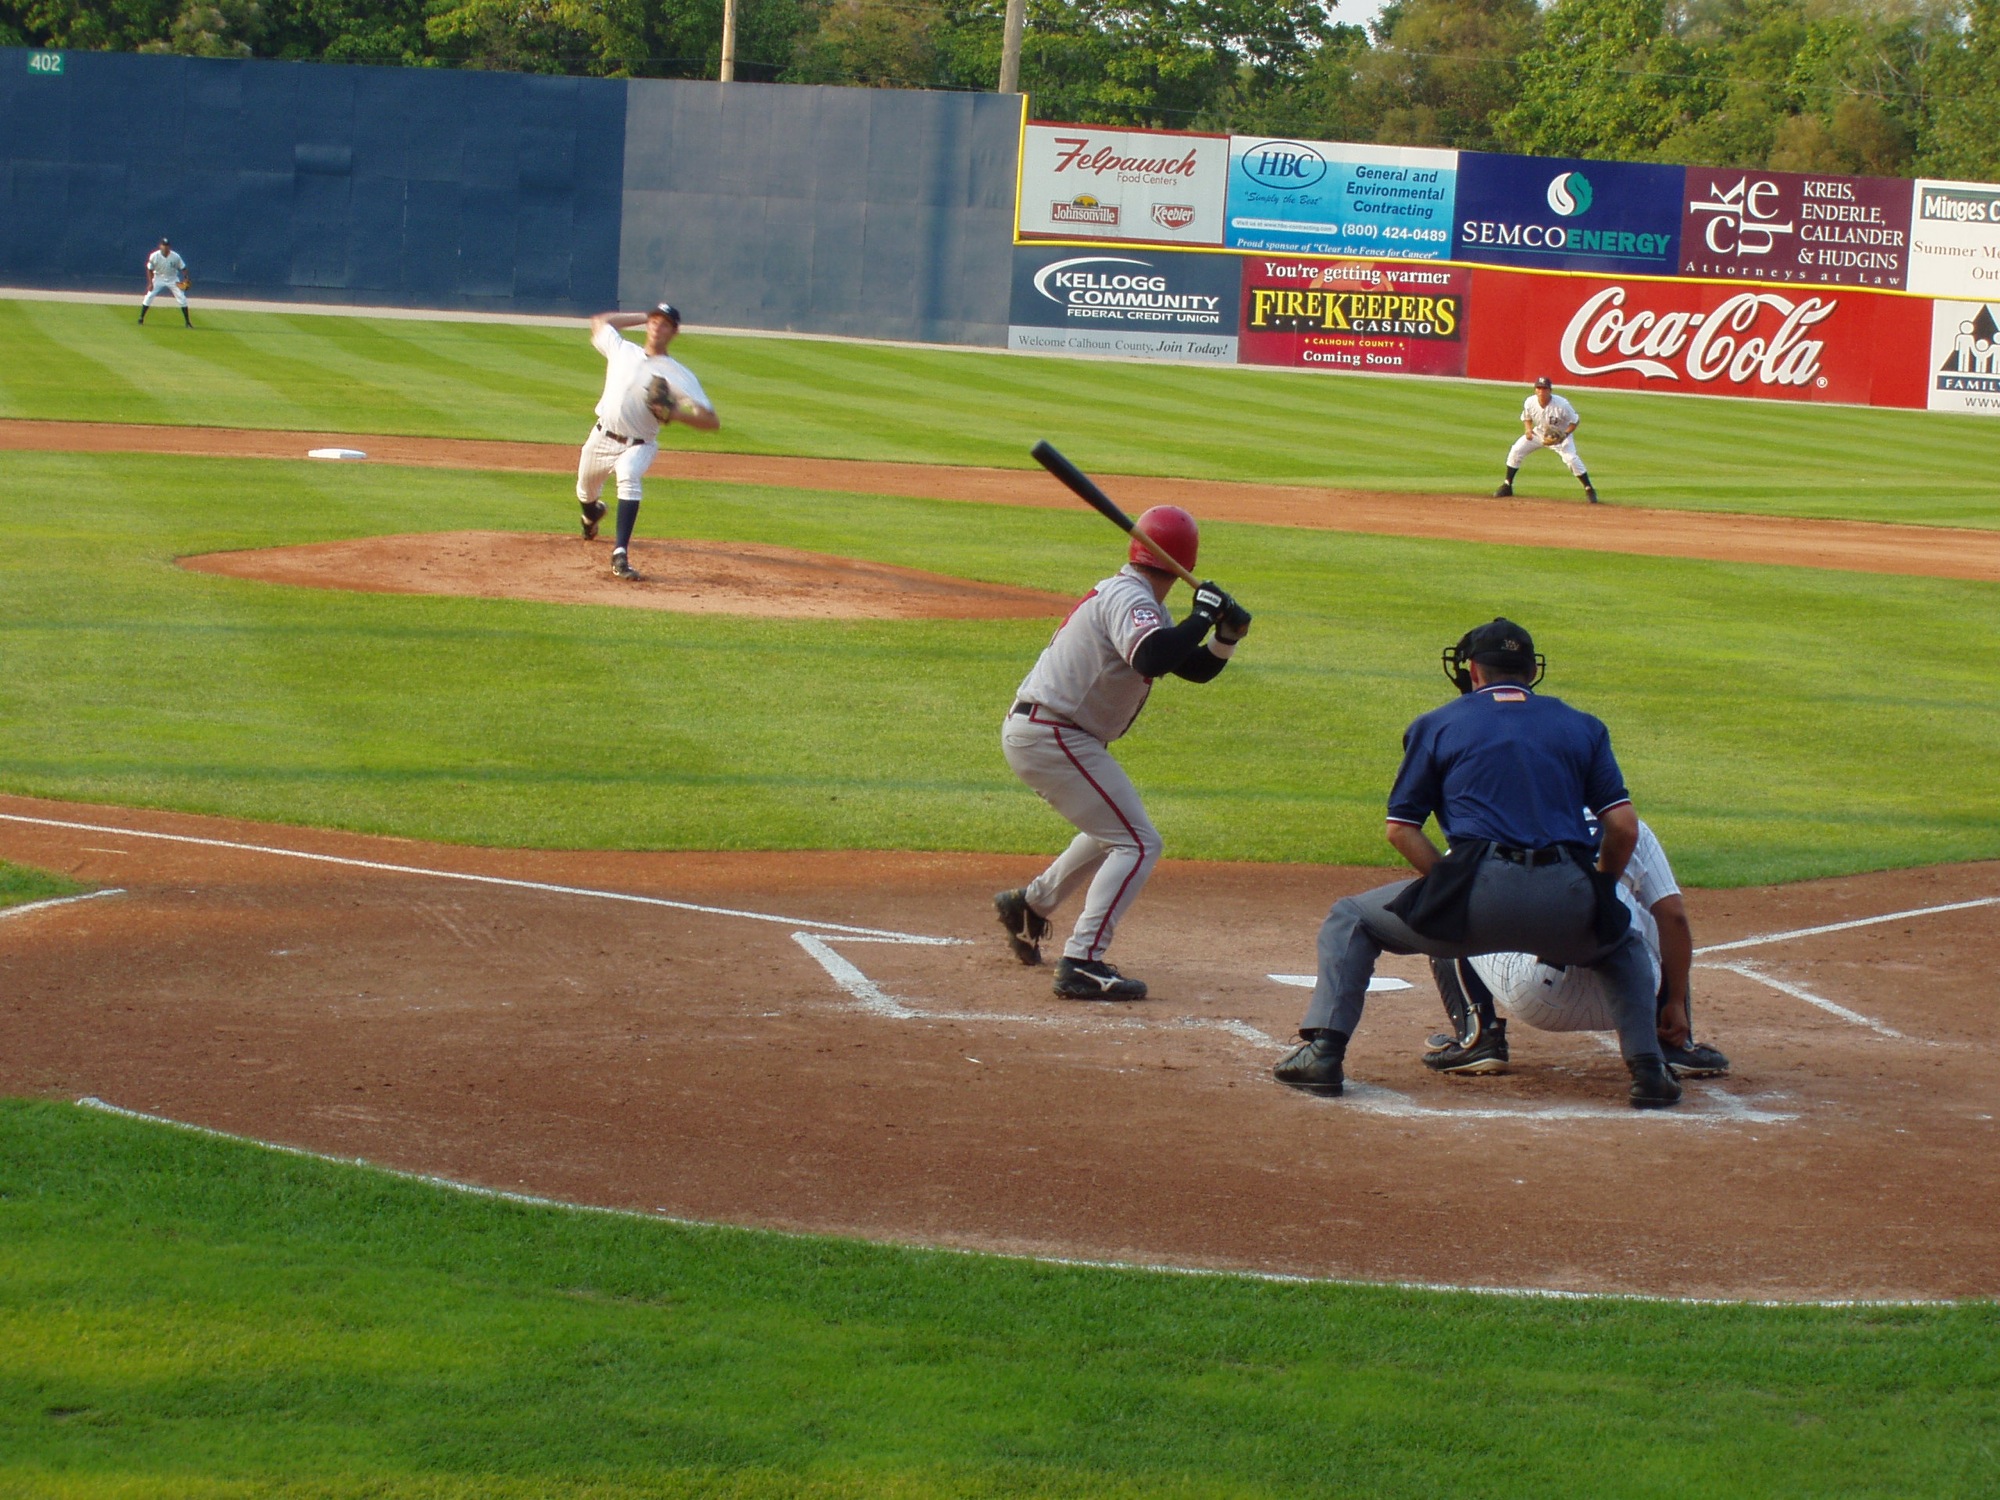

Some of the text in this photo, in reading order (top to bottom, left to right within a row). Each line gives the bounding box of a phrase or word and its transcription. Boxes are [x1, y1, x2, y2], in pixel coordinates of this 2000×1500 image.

[30, 53, 61, 72] 402
[1054, 137, 1197, 177] Felpausch
[1257, 151, 1314, 178] HBC
[1117, 172, 1178, 186] Food Centers
[1356, 166, 1438, 183] General and
[1283, 194, 1295, 204] the
[1346, 182, 1445, 201] Environmental
[1803, 181, 1856, 202] KREIS,
[1054, 205, 1115, 223] Johnsonville
[1153, 204, 1194, 222] Keebler
[1353, 201, 1434, 219] Contracting
[1802, 204, 1886, 226] ENDERLE,
[1925, 195, 1985, 221] Minges
[1342, 223, 1447, 241] (800) 424-0489
[1801, 225, 1903, 247] CALLANDER
[1237, 238, 1263, 248] Proud
[1266, 240, 1299, 251] sponsor
[1301, 243, 1312, 252] of
[1344, 246, 1358, 254] the
[1359, 247, 1385, 256] Fence
[1387, 248, 1400, 258] for
[1914, 241, 1977, 257] Summer
[1798, 248, 1898, 270] & HUDGINS
[1056, 272, 1165, 291] KELLOGG
[1265, 263, 1450, 284] You're getting warmer
[1686, 261, 1900, 285] Attorneys at Law
[1069, 291, 1219, 310] COMMUNITY
[1067, 308, 1219, 323] FEDERAL CREDIT UNION
[1353, 320, 1431, 334] CASINO
[1560, 286, 1837, 385] Coca-Cola
[1019, 335, 1066, 347] Welcome
[1069, 337, 1110, 349] Calhoun
[1156, 340, 1182, 353] Join
[1187, 342, 1228, 355] Today!
[1313, 338, 1355, 346] CALHOUN
[1303, 350, 1402, 365] Coming Soon
[1945, 379, 2000, 391] FAMIL
